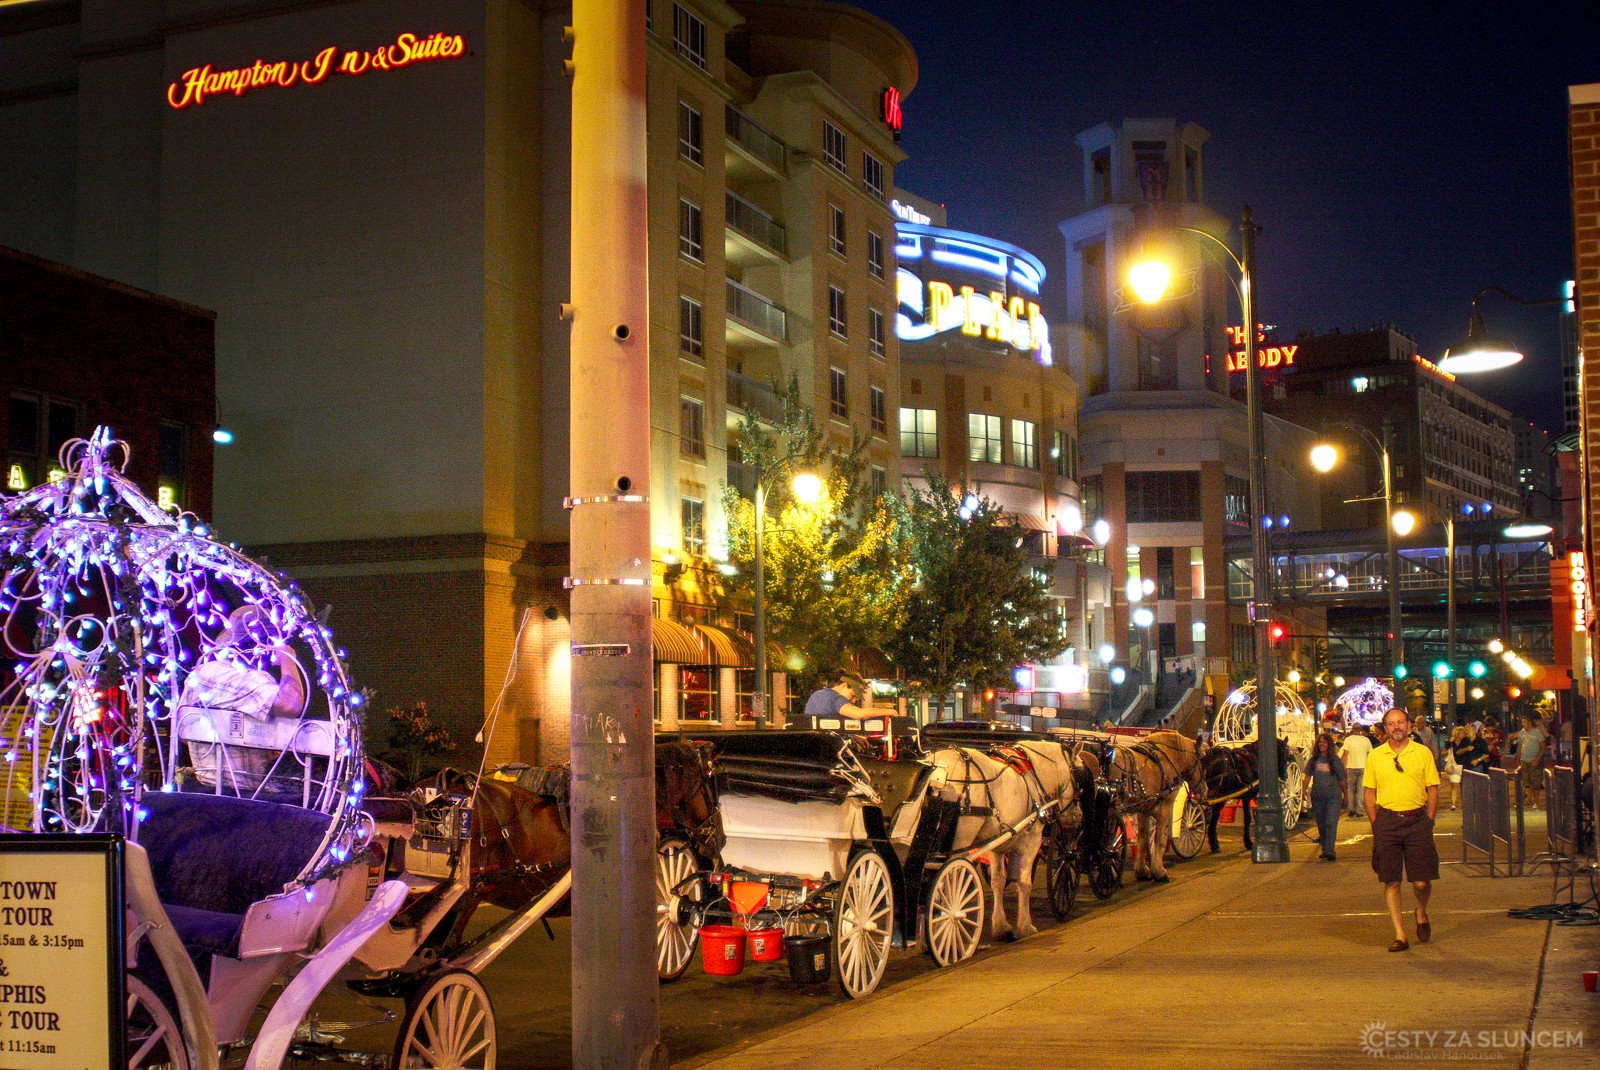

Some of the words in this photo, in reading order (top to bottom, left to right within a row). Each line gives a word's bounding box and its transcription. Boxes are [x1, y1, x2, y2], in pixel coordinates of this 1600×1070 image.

[167, 59, 298, 108] Hampton
[371, 46, 390, 69] &
[387, 32, 465, 67] Suites
[1, 907, 54, 926] TOUR
[28, 934, 39, 946] &
[42, 935, 84, 950] 3:15pm
[8, 1011, 60, 1031] TOUR
[8, 1040, 56, 1054] 11:15am
